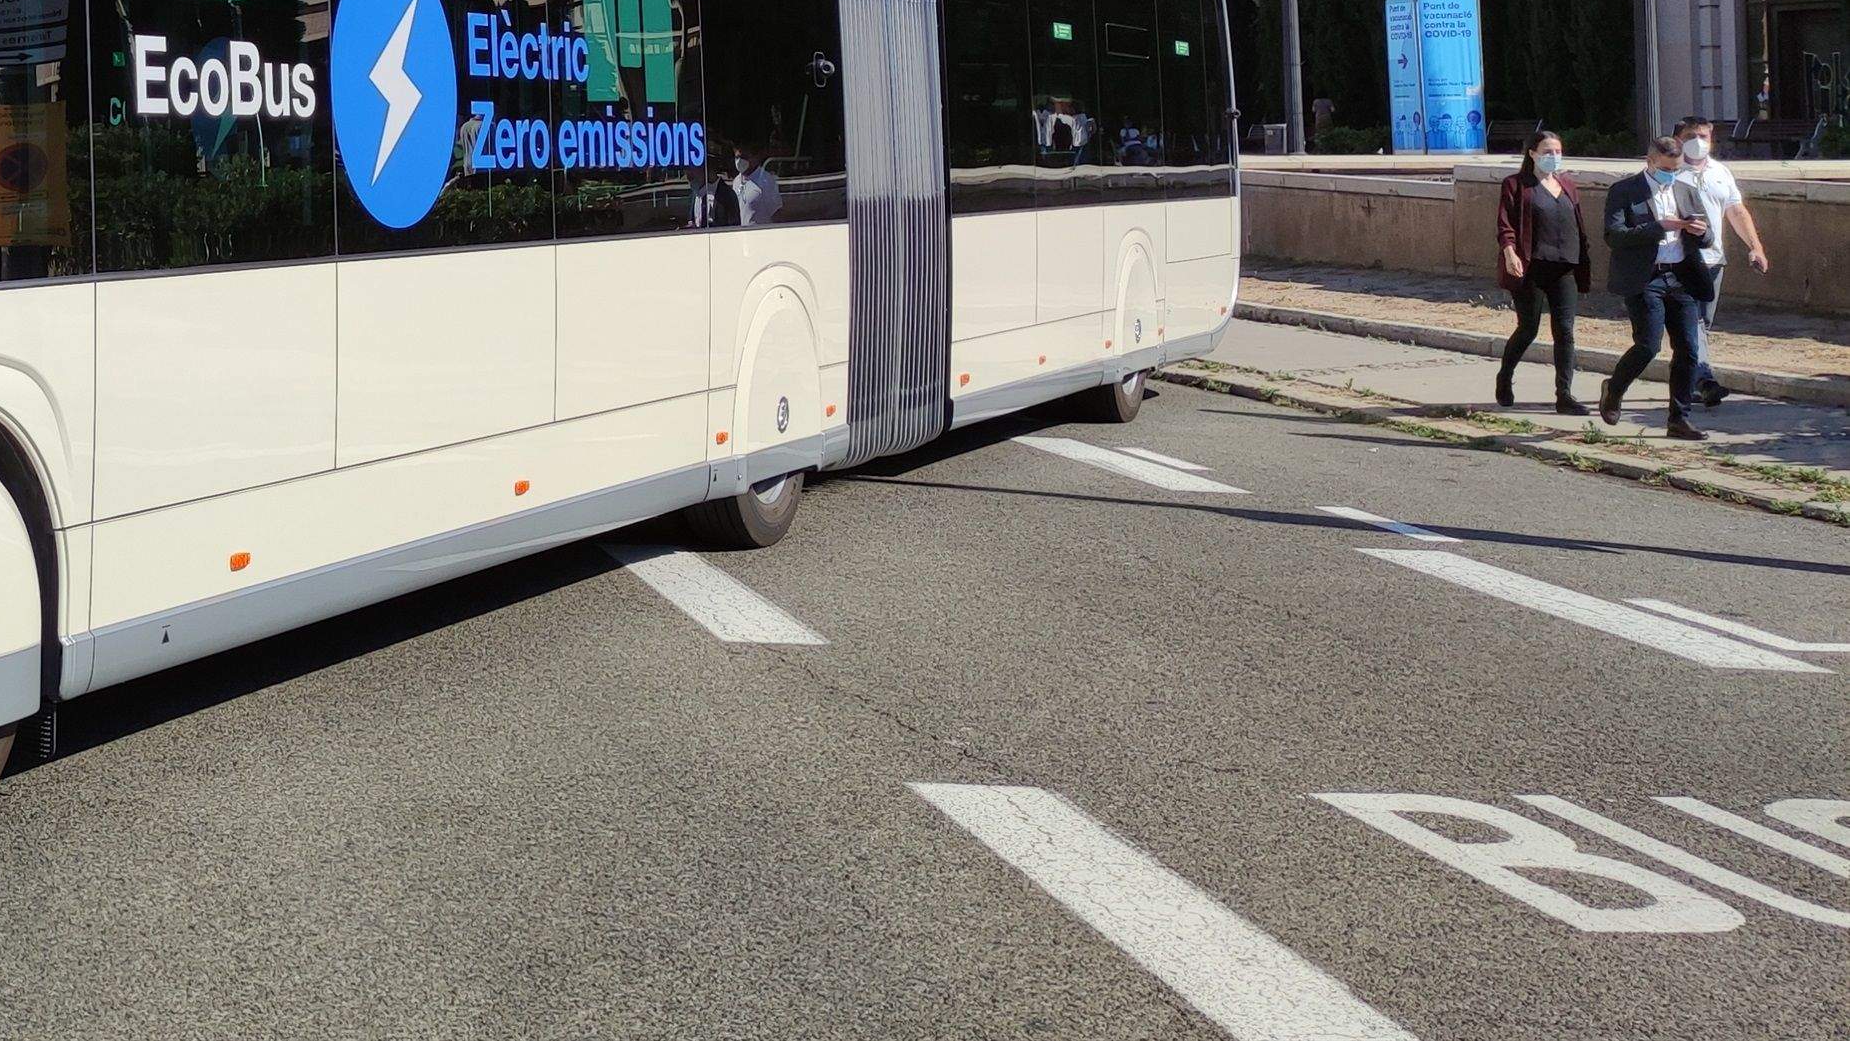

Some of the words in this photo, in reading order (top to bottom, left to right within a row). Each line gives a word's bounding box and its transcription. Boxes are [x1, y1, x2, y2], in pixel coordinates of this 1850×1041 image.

[1424, 10, 1473, 20] vacunació
[1424, 21, 1456, 29] contra
[1457, 20, 1467, 29] la
[1425, 30, 1472, 38] COVID-19
[467, 10, 590, 83] Elèctric
[134, 34, 317, 118] EcoBus
[471, 100, 552, 170] Zero
[558, 105, 707, 170] emissions
